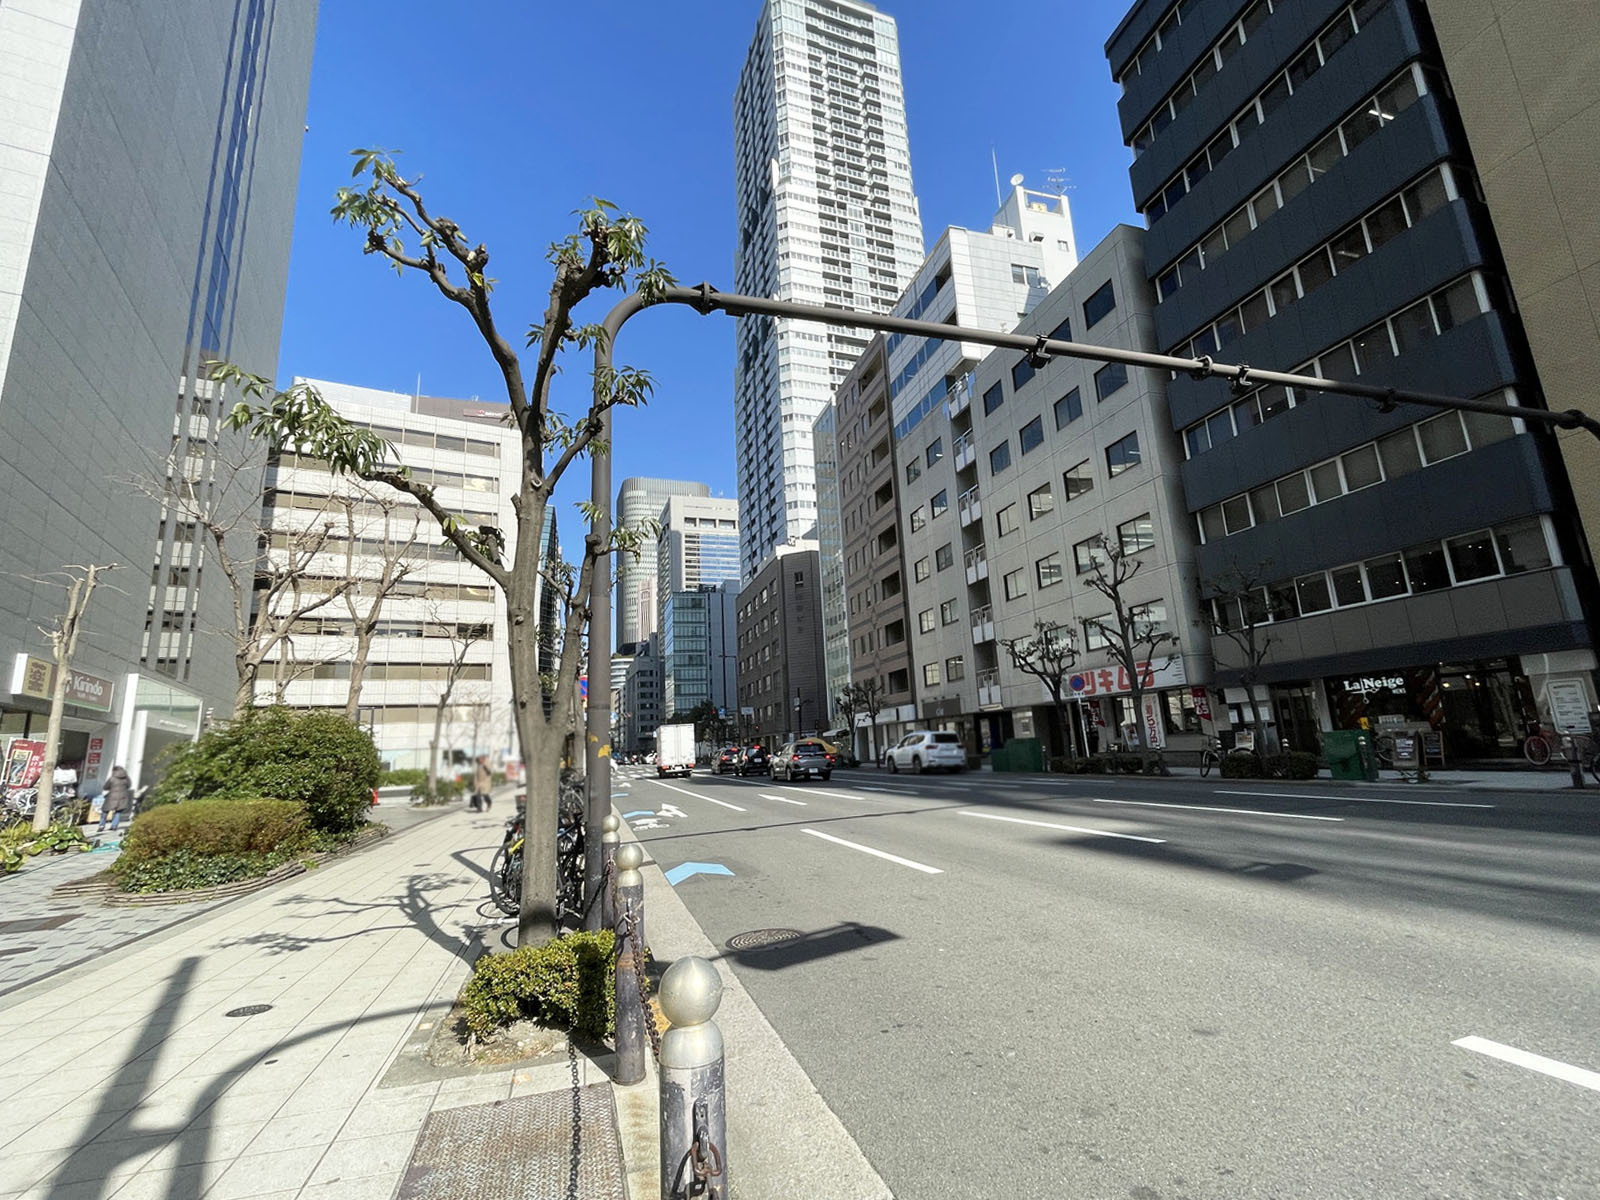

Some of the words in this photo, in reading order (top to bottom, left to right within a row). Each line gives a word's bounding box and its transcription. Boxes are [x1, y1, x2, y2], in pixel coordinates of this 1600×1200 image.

[73, 676, 103, 696] Kirindo
[1343, 680, 1360, 691] La
[1362, 676, 1404, 689] Neige
